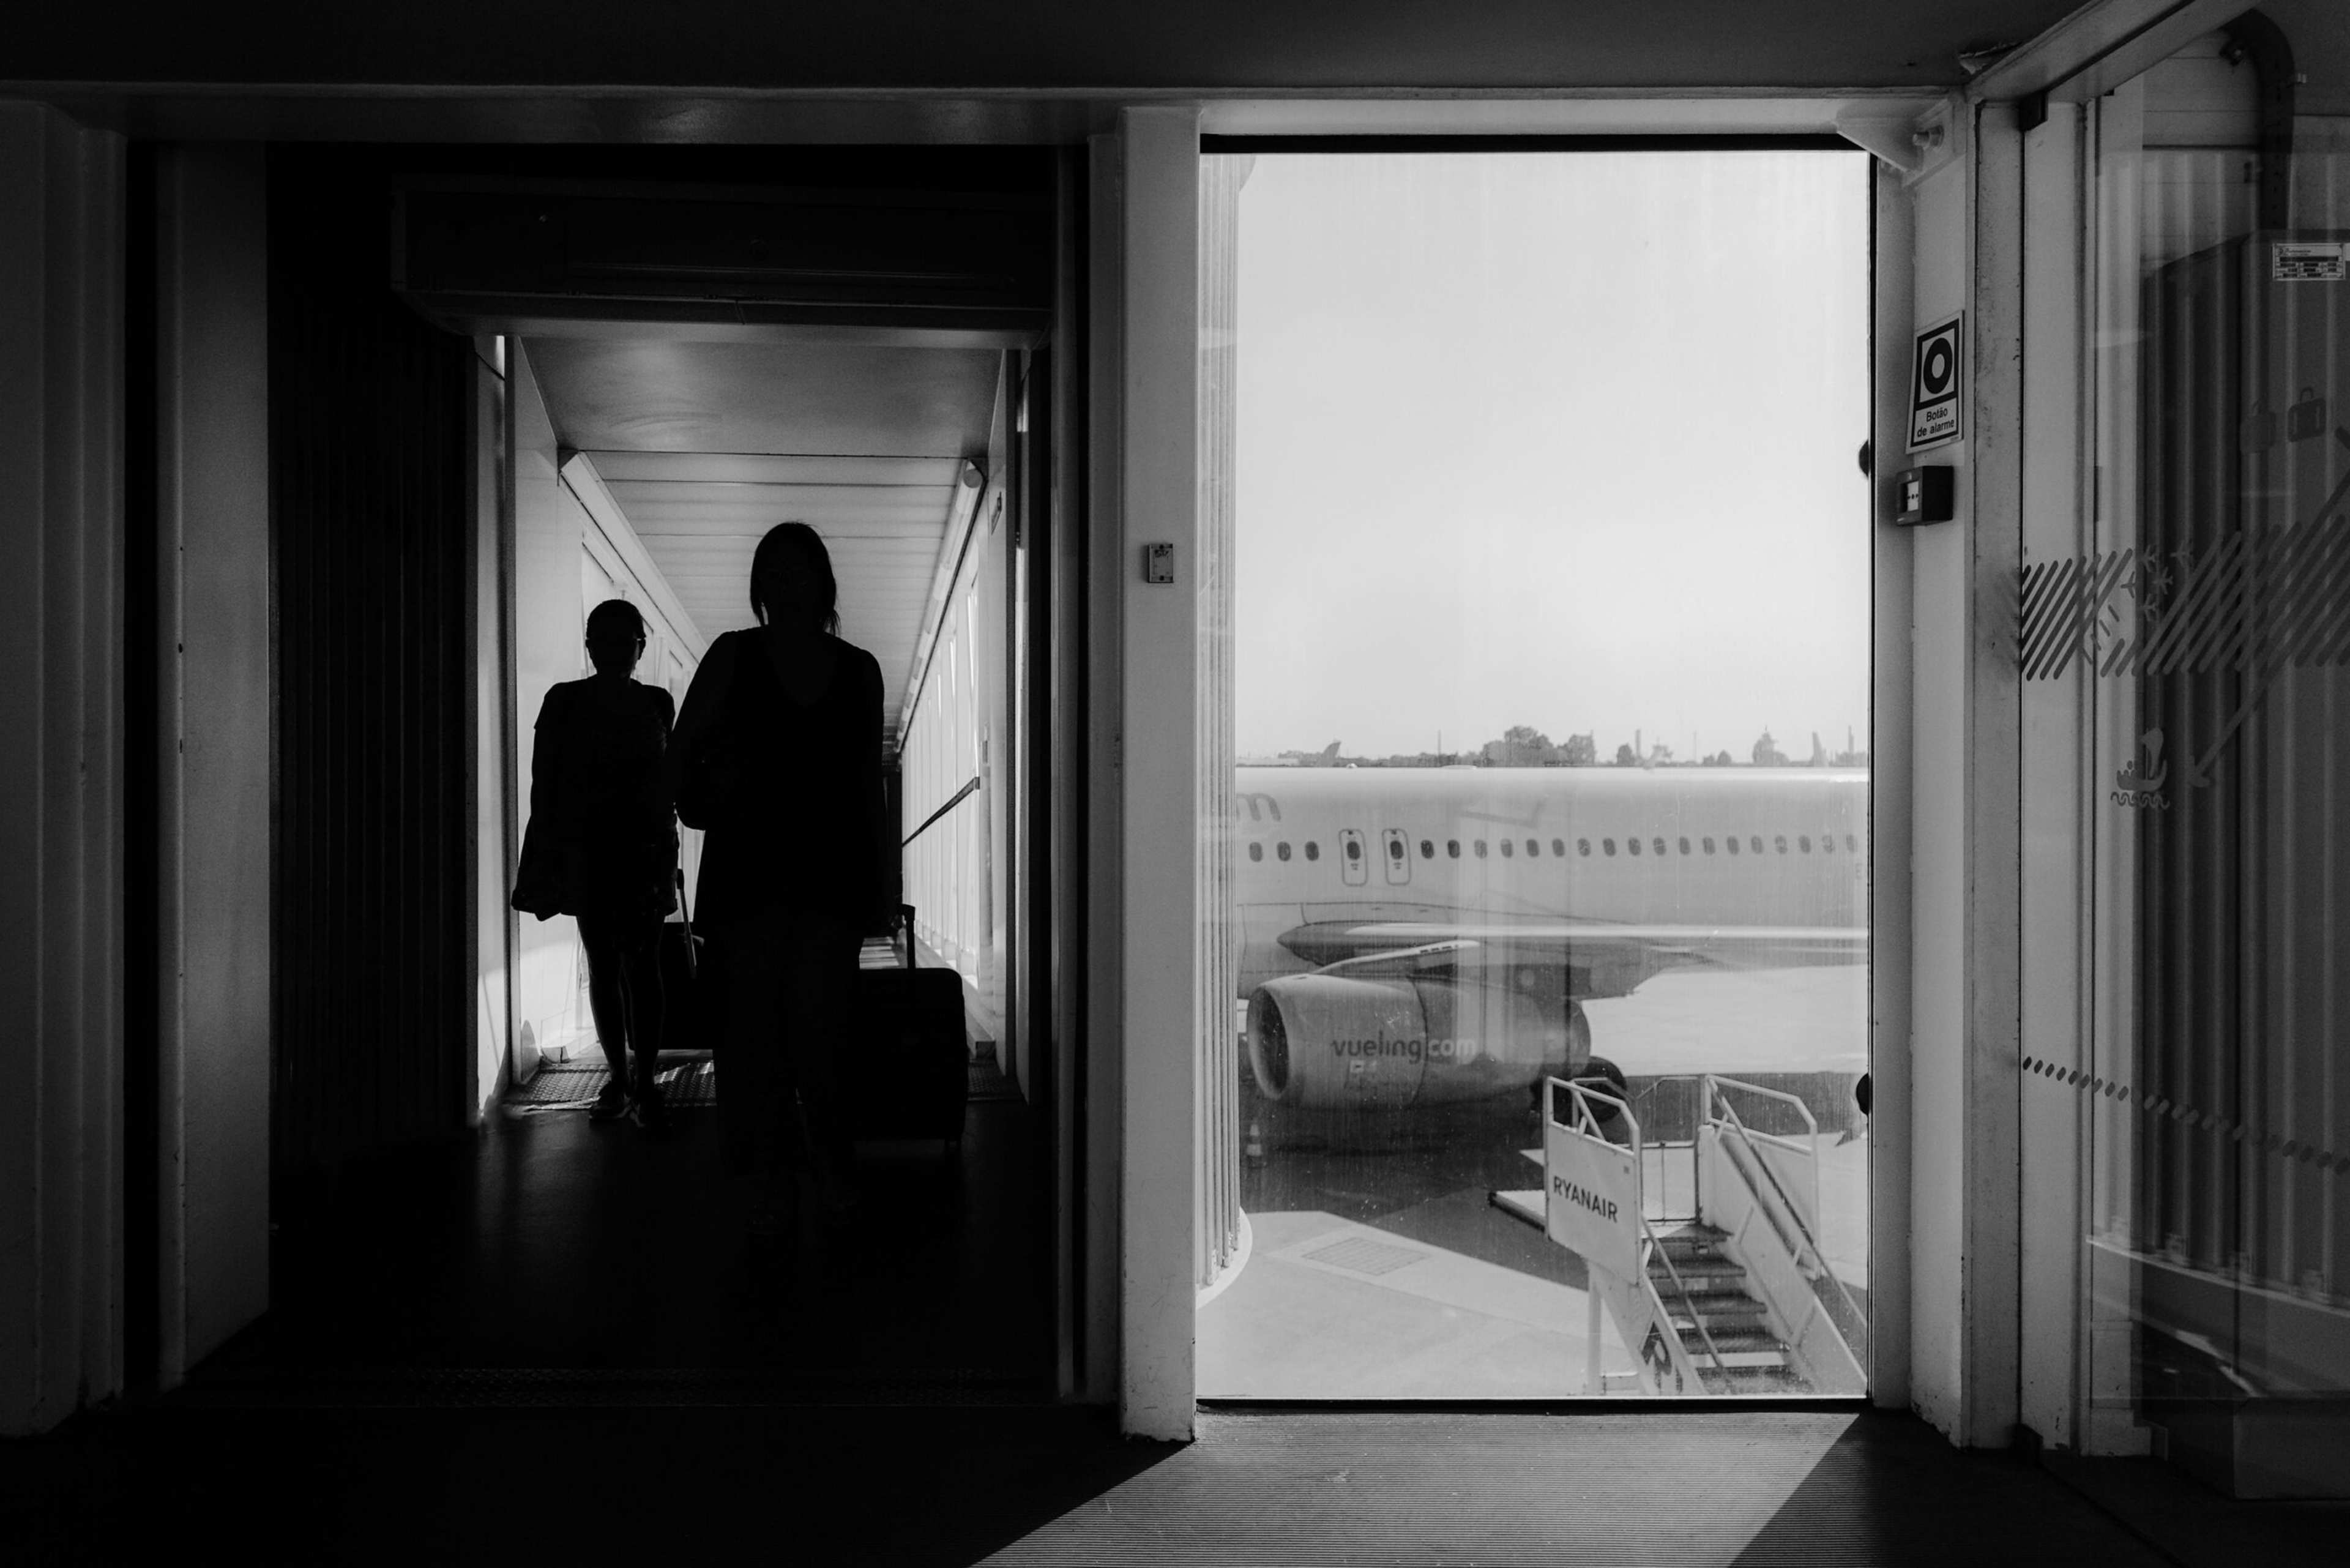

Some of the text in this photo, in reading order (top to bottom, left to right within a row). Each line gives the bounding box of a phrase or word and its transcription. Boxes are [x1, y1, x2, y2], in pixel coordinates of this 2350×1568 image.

[1926, 407, 1948, 422] Botão
[1917, 419, 1955, 438] de alarme
[1330, 1029, 1477, 1065] vuelingcom
[1553, 1174, 1617, 1223] RYANAIR
